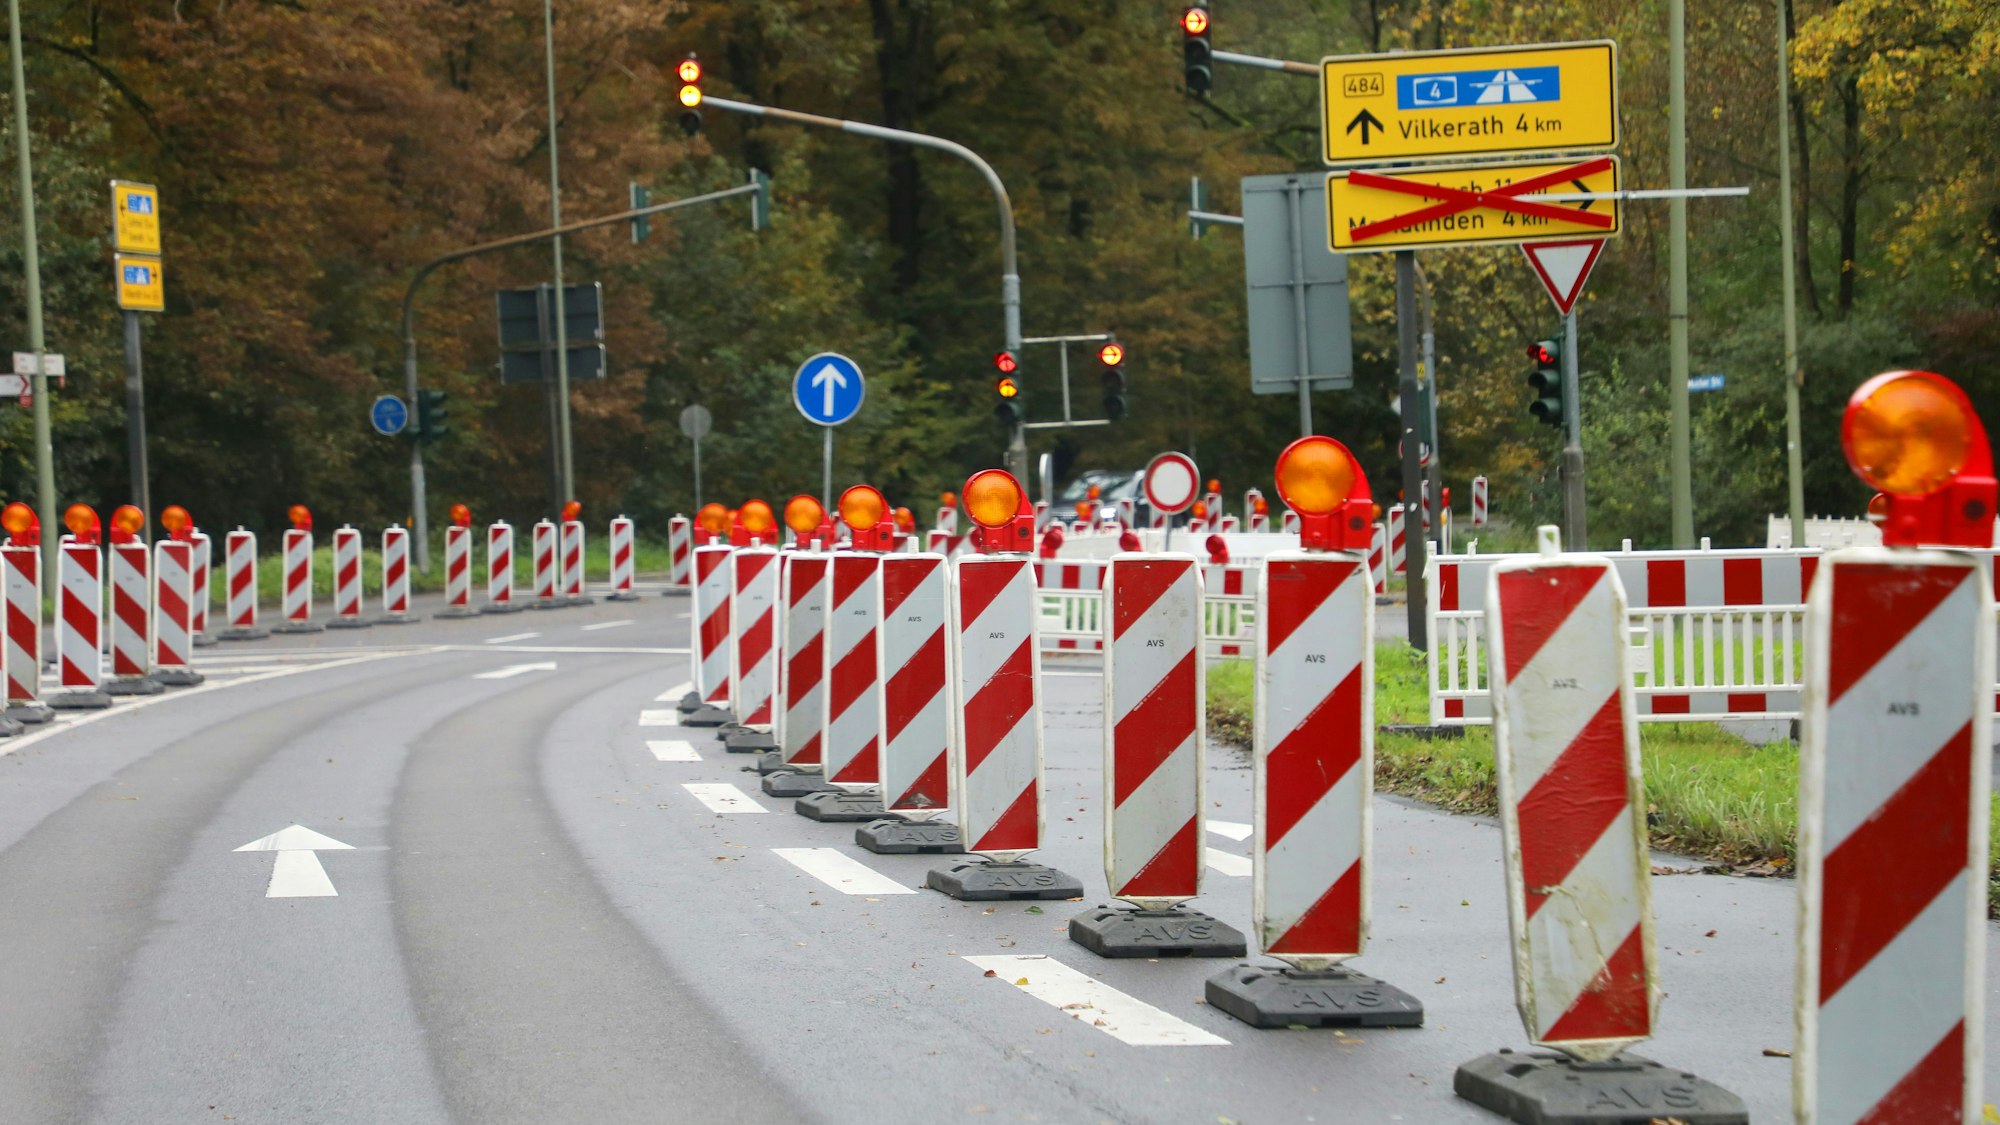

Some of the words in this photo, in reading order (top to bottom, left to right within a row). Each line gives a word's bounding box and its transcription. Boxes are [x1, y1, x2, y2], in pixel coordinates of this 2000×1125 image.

[1347, 77, 1380, 94] 484
[1429, 82, 1442, 100] 4
[1398, 115, 1504, 140] Vilkerath
[1515, 112, 1529, 133] 4
[1535, 116, 1562, 132] km
[989, 631, 1005, 640] AVS
[1146, 639, 1165, 648] AVS
[1304, 653, 1326, 664] AVS
[1552, 678, 1577, 690] AVS
[1886, 702, 1920, 717] AVS
[899, 831, 959, 842] AVS
[987, 874, 1055, 887] AVS
[1133, 923, 1213, 941] AVS
[1292, 990, 1384, 1010] AVS
[1585, 1086, 1698, 1109] AVS
